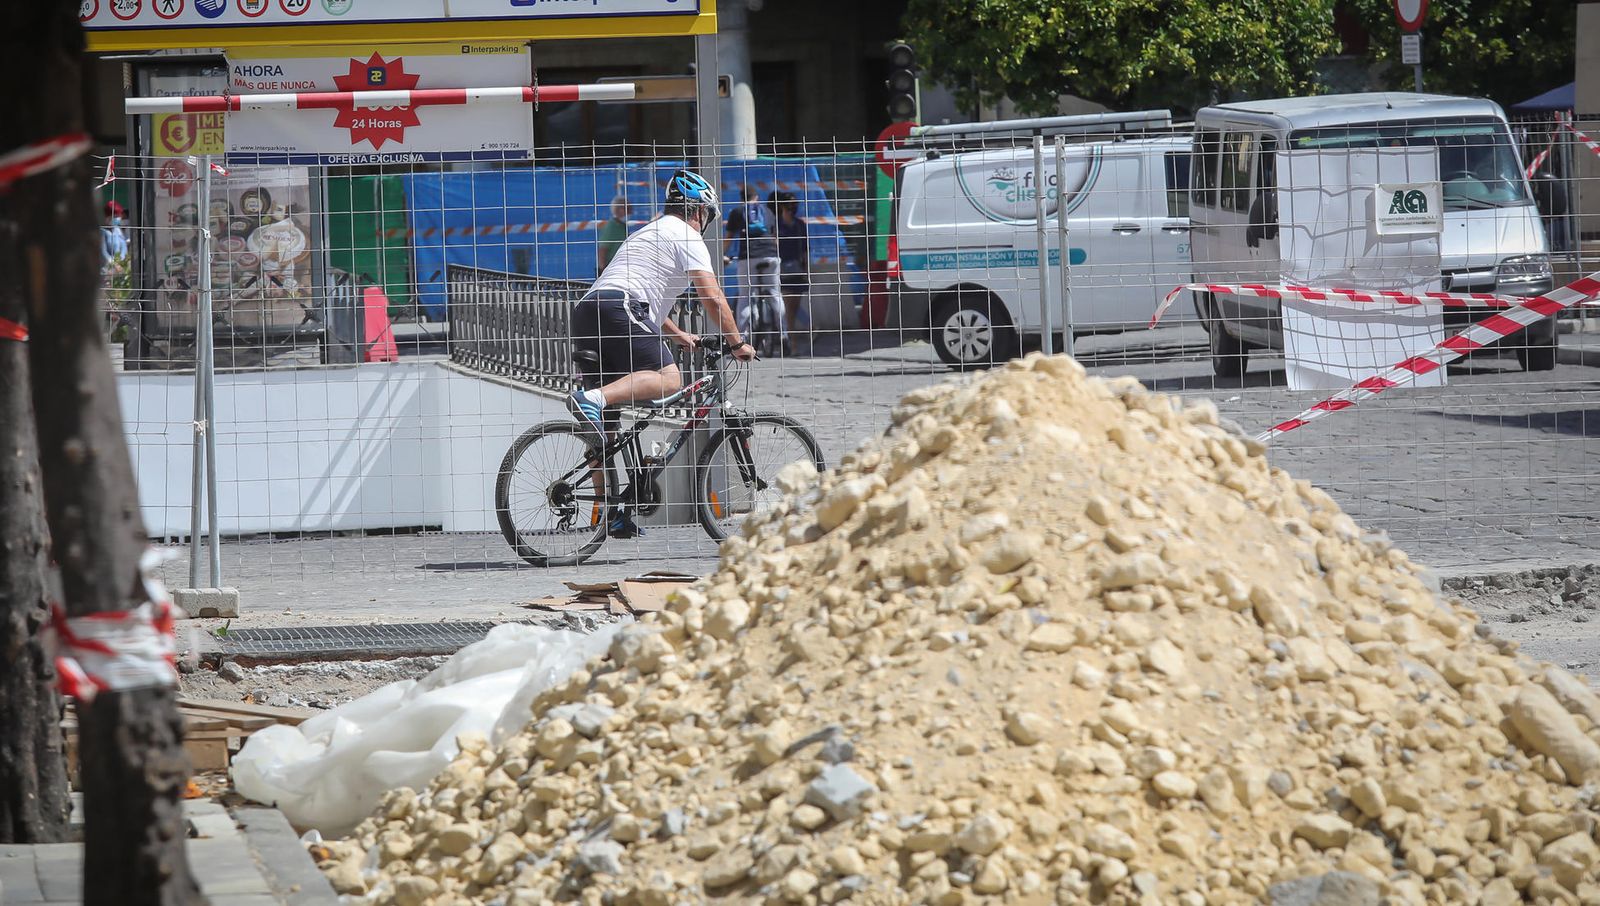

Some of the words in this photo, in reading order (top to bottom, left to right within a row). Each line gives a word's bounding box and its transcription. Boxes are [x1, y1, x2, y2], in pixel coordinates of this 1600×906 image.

[471, 45, 519, 54] Interparking
[234, 65, 284, 77] AHORA
[257, 81, 278, 90] QUE
[280, 80, 316, 90] NUNCA
[352, 118, 365, 129] 24
[368, 118, 402, 128] Horas
[328, 155, 367, 163] OFERTA
[369, 154, 425, 163] EXCLUSIVA
